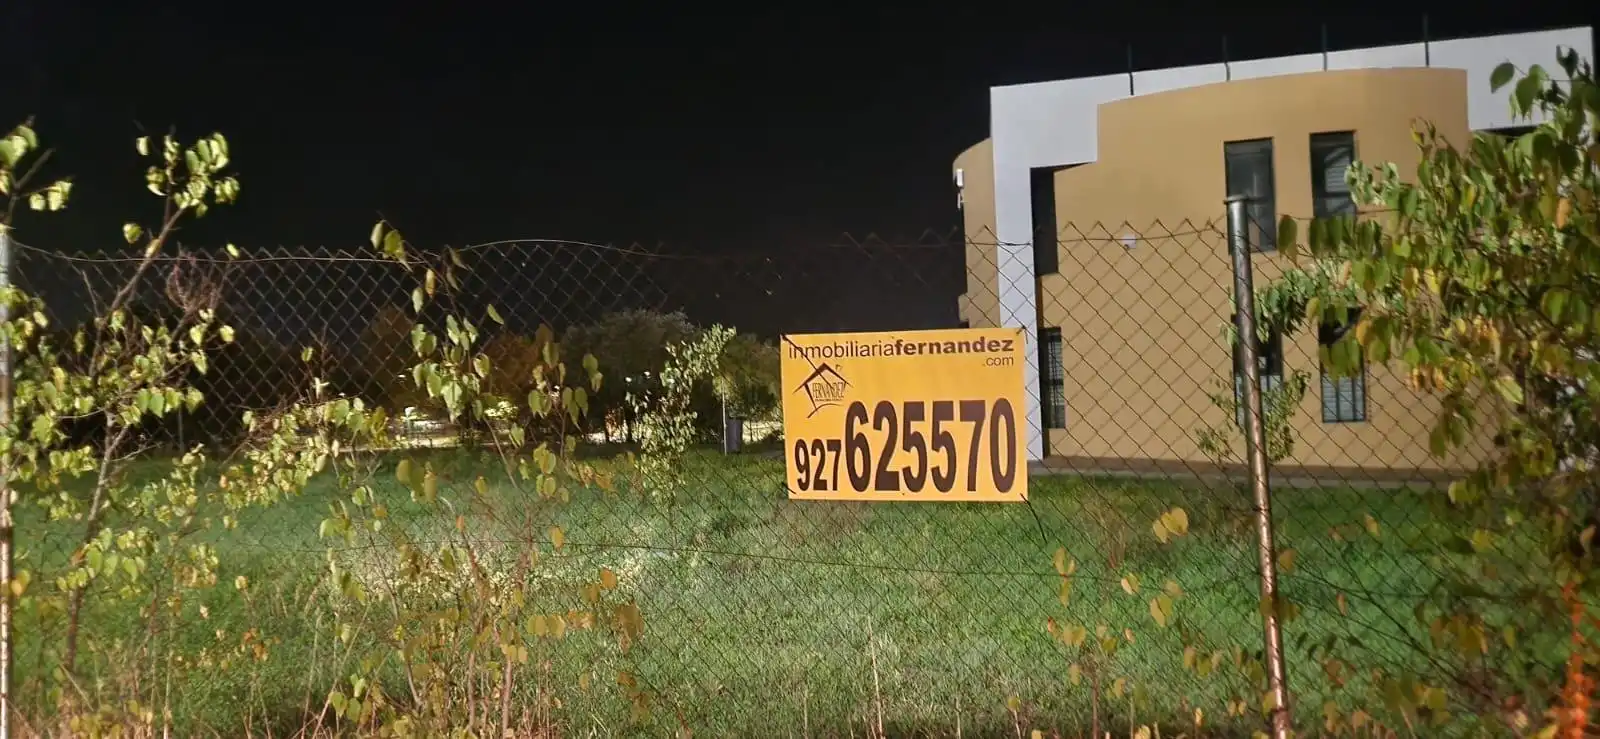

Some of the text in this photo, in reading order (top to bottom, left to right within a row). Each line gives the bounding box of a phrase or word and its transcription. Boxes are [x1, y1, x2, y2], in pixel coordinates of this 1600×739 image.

[982, 355, 1015, 367] .com
[794, 397, 1017, 493] 927 625570
